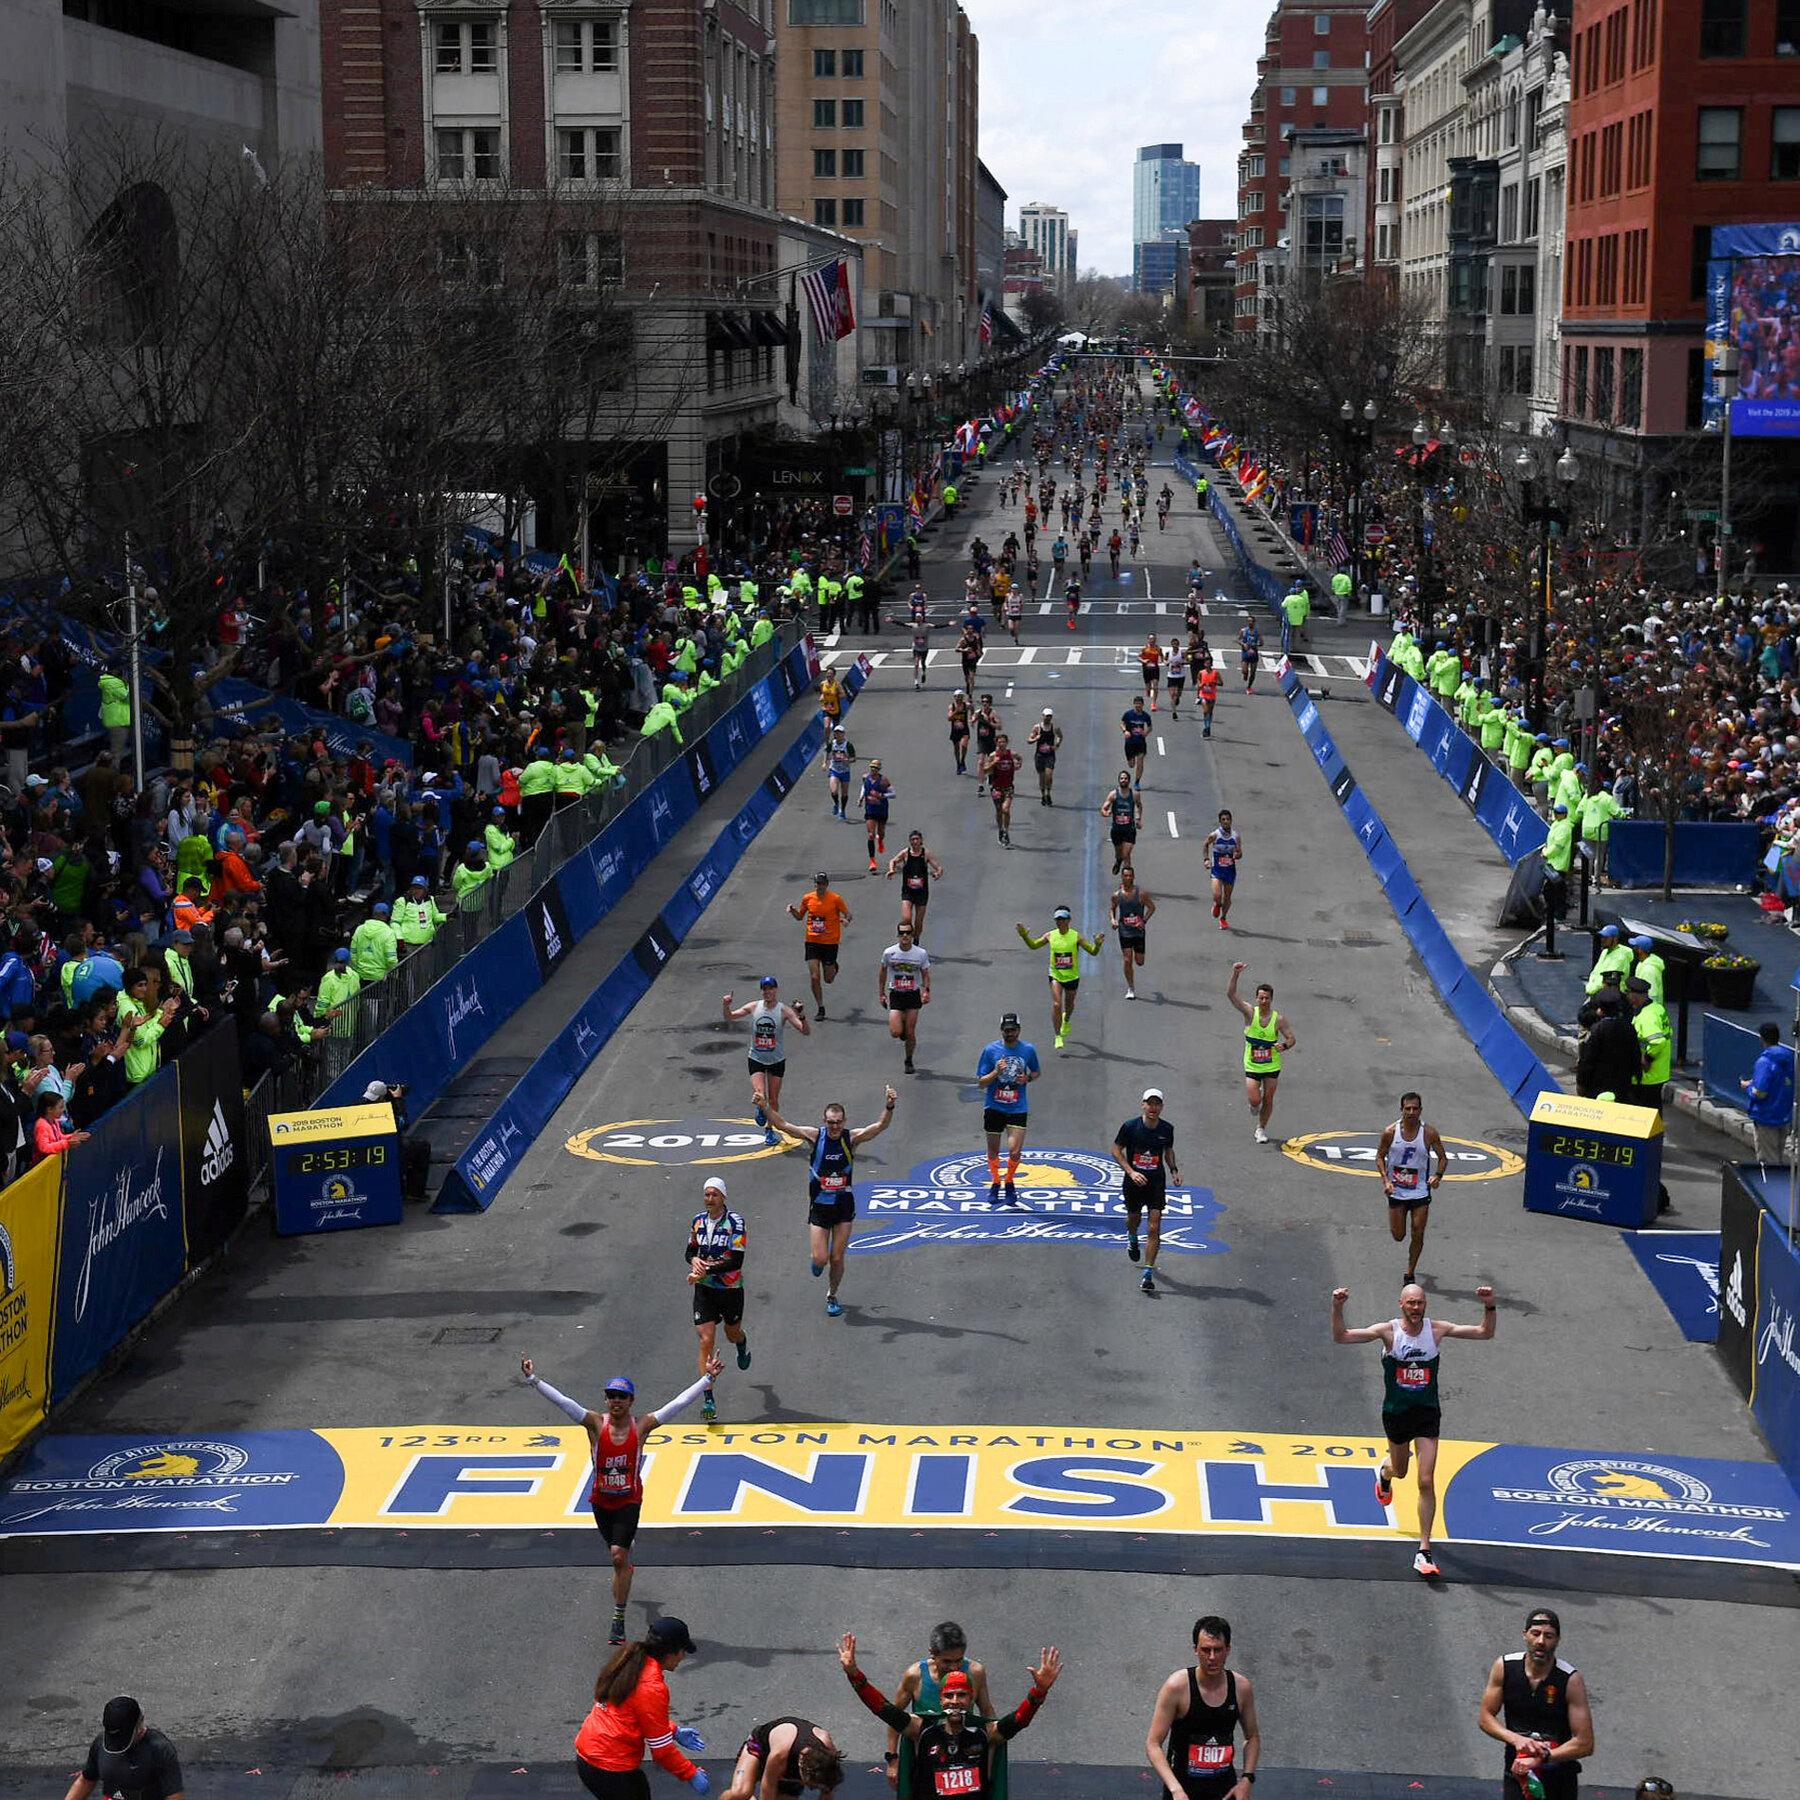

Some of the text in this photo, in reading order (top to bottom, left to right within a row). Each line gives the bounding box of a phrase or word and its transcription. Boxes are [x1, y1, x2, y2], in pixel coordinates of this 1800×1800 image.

[293, 1122, 343, 1132] MARATHON
[309, 1116, 342, 1125] BOSTON
[603, 1134, 767, 1148] 2019
[302, 1145, 385, 1172] 2:53:19
[1401, 1147, 1416, 1165] F
[1553, 1136, 1634, 1166] 2:53:19
[201, 1142, 234, 1186] adidas
[870, 1189, 1192, 1204] 2019 OSTN
[1555, 1184, 1610, 1198] BOSTON MARATHON
[310, 1196, 367, 1207] BOSTON MARATHON
[75, 1145, 168, 1324] John Hancock
[848, 1221, 996, 1249] John
[1403, 1369, 1424, 1381] 1429
[379, 1433, 1414, 1458] 123RD OSTON MARATHON 201
[12, 1474, 292, 1491] BOSTON MARATHON
[1, 1493, 242, 1525] John Hancock
[1491, 1489, 1784, 1520] BOSTON MARATHON
[1528, 1511, 1772, 1548] John Hancock
[1197, 1746, 1226, 1763] 1907
[942, 1769, 974, 1789] 1218
